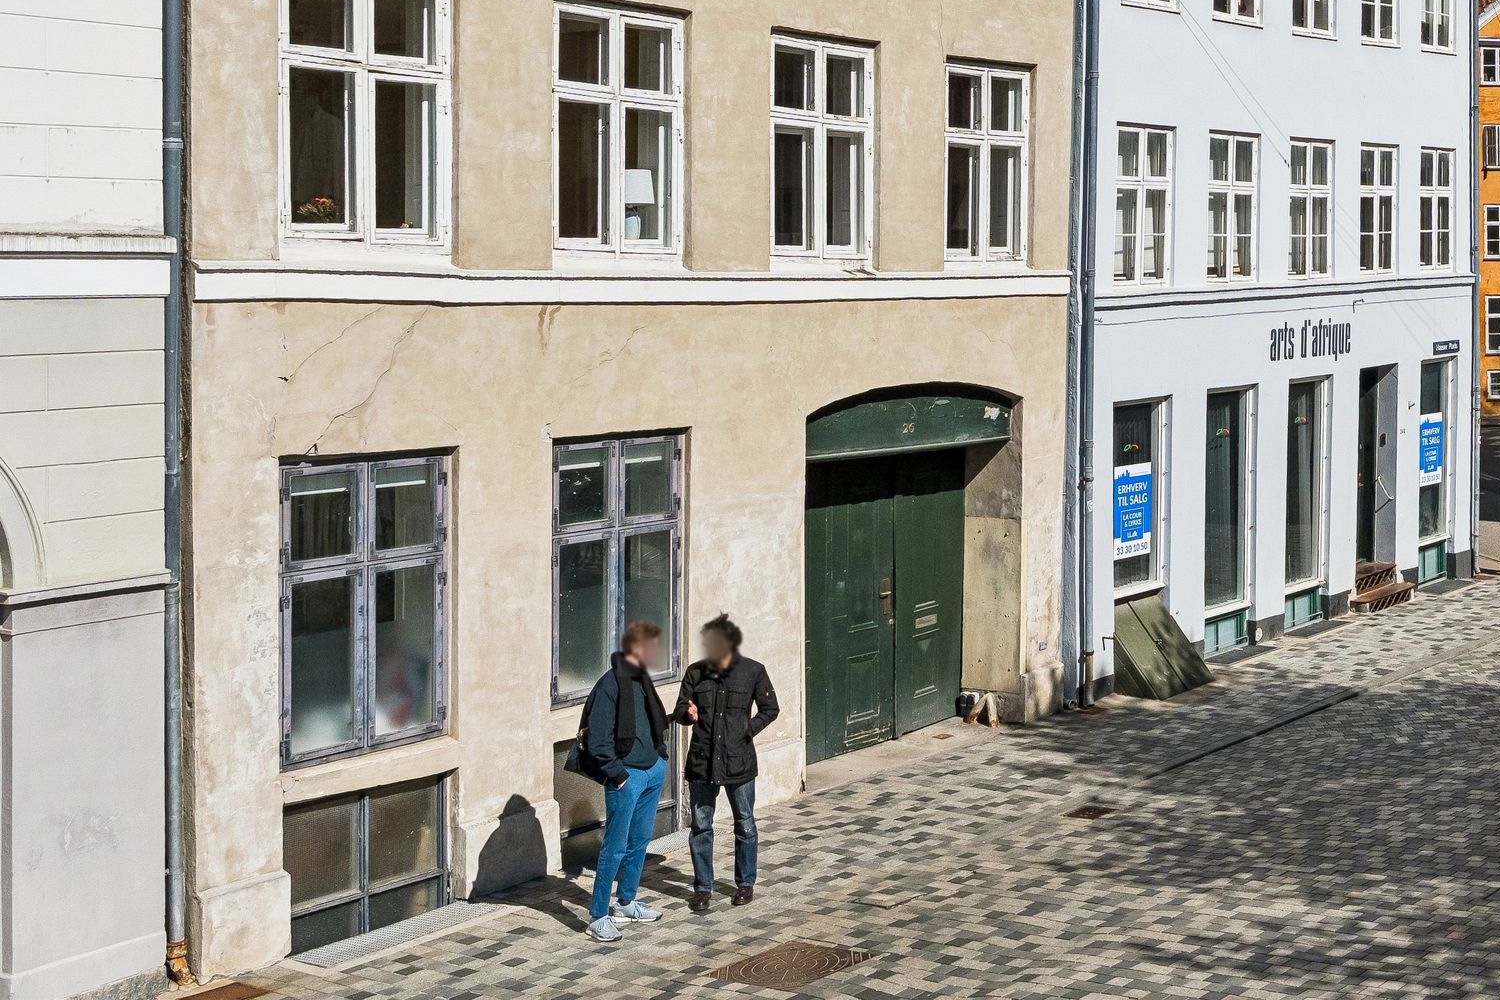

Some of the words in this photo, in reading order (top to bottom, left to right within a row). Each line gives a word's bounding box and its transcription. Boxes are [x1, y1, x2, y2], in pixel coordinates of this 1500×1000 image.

[1270, 322, 1295, 361] arts
[1301, 318, 1351, 361] d'afrique
[902, 422, 915, 434] 26
[1429, 436, 1440, 445] SALG
[1118, 481, 1148, 494] ERHVERV
[1118, 497, 1128, 507] TIL
[1129, 493, 1148, 505] SALG
[1129, 511, 1142, 520] COUR
[1116, 547, 1124, 556] 33
[1125, 545, 1132, 554] 30
[1133, 543, 1140, 553] 10
[1140, 541, 1148, 551] 50
